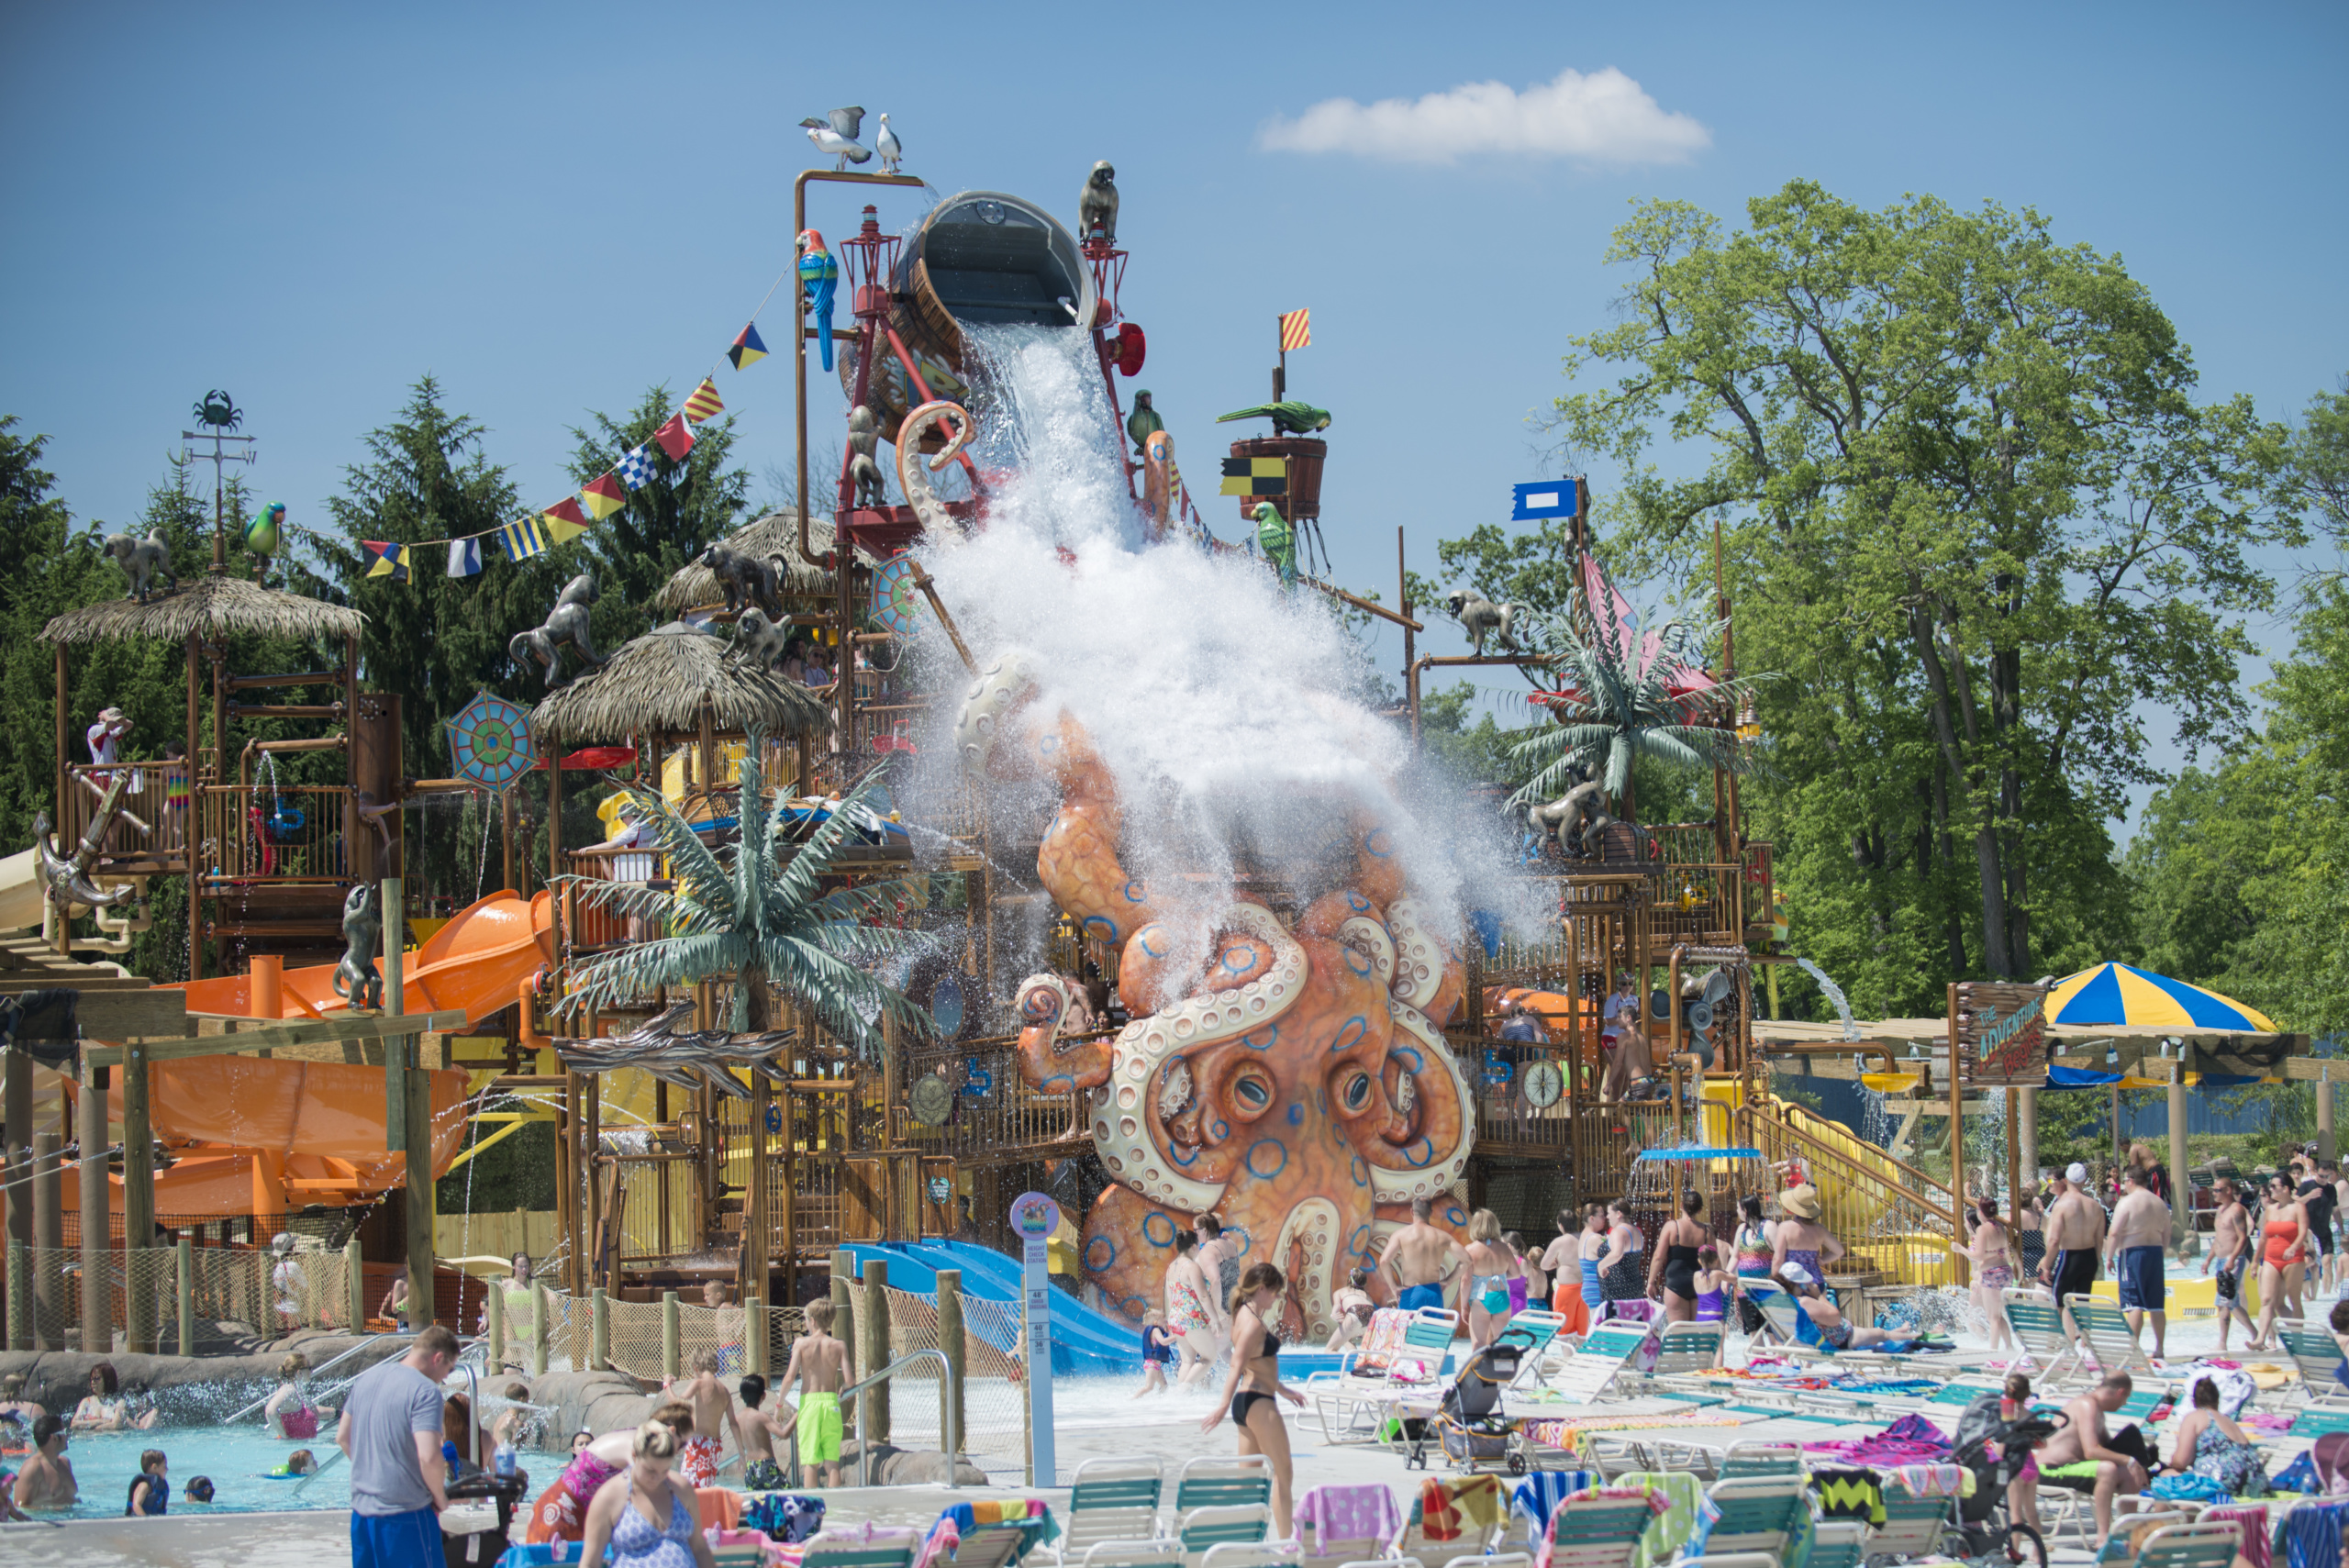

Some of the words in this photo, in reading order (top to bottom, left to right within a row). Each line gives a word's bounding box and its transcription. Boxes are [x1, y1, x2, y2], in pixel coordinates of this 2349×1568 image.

[1978, 1005, 1998, 1028] THE
[1978, 996, 2041, 1074] ADVENTURE
[2003, 1029, 2042, 1078] Begins
